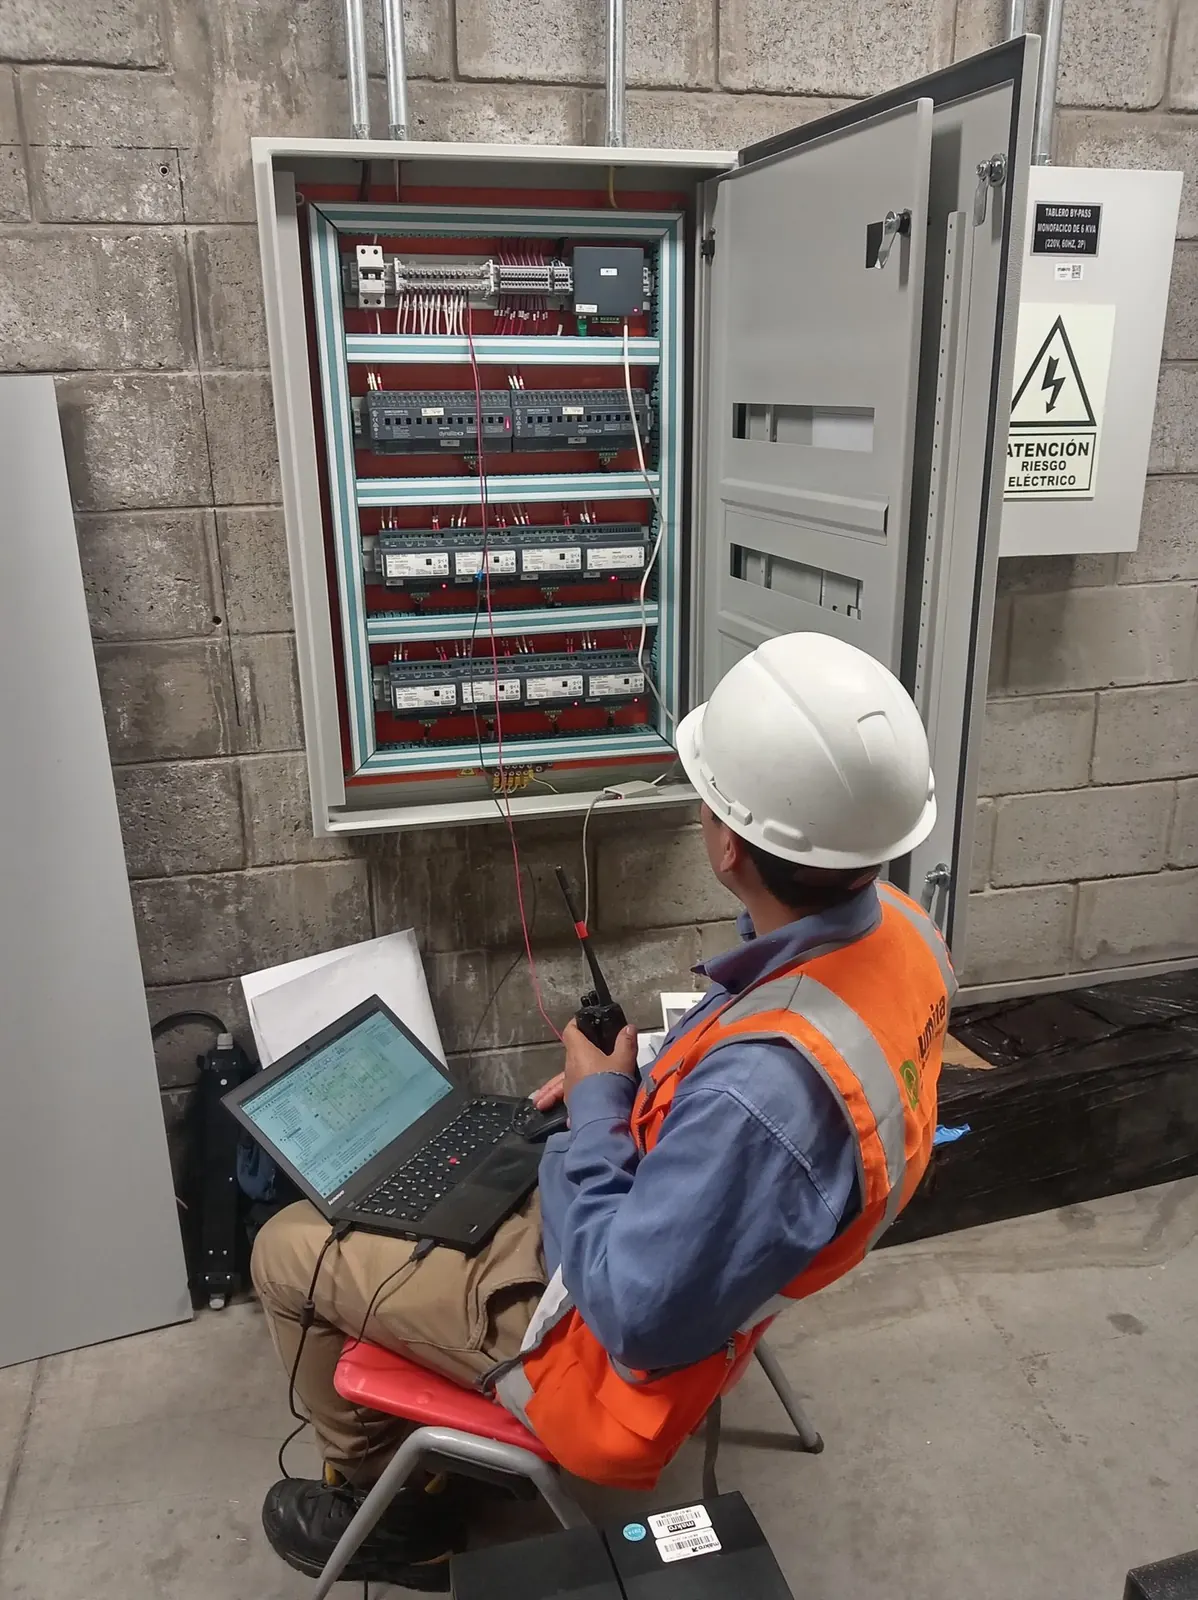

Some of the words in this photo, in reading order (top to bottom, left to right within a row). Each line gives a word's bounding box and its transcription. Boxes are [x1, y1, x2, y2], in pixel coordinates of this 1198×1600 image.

[1045, 207, 1069, 217] TABLERO
[1070, 208, 1091, 218] BY-PASS
[1073, 224, 1080, 233] DE
[1085, 225, 1096, 233] KVA
[1007, 438, 1089, 457] ATENCIÓN
[1021, 460, 1067, 471] RIESGO
[1008, 473, 1076, 487] ELÉCTRICO
[668, 1520, 695, 1532] makro
[698, 1542, 720, 1551] makro
